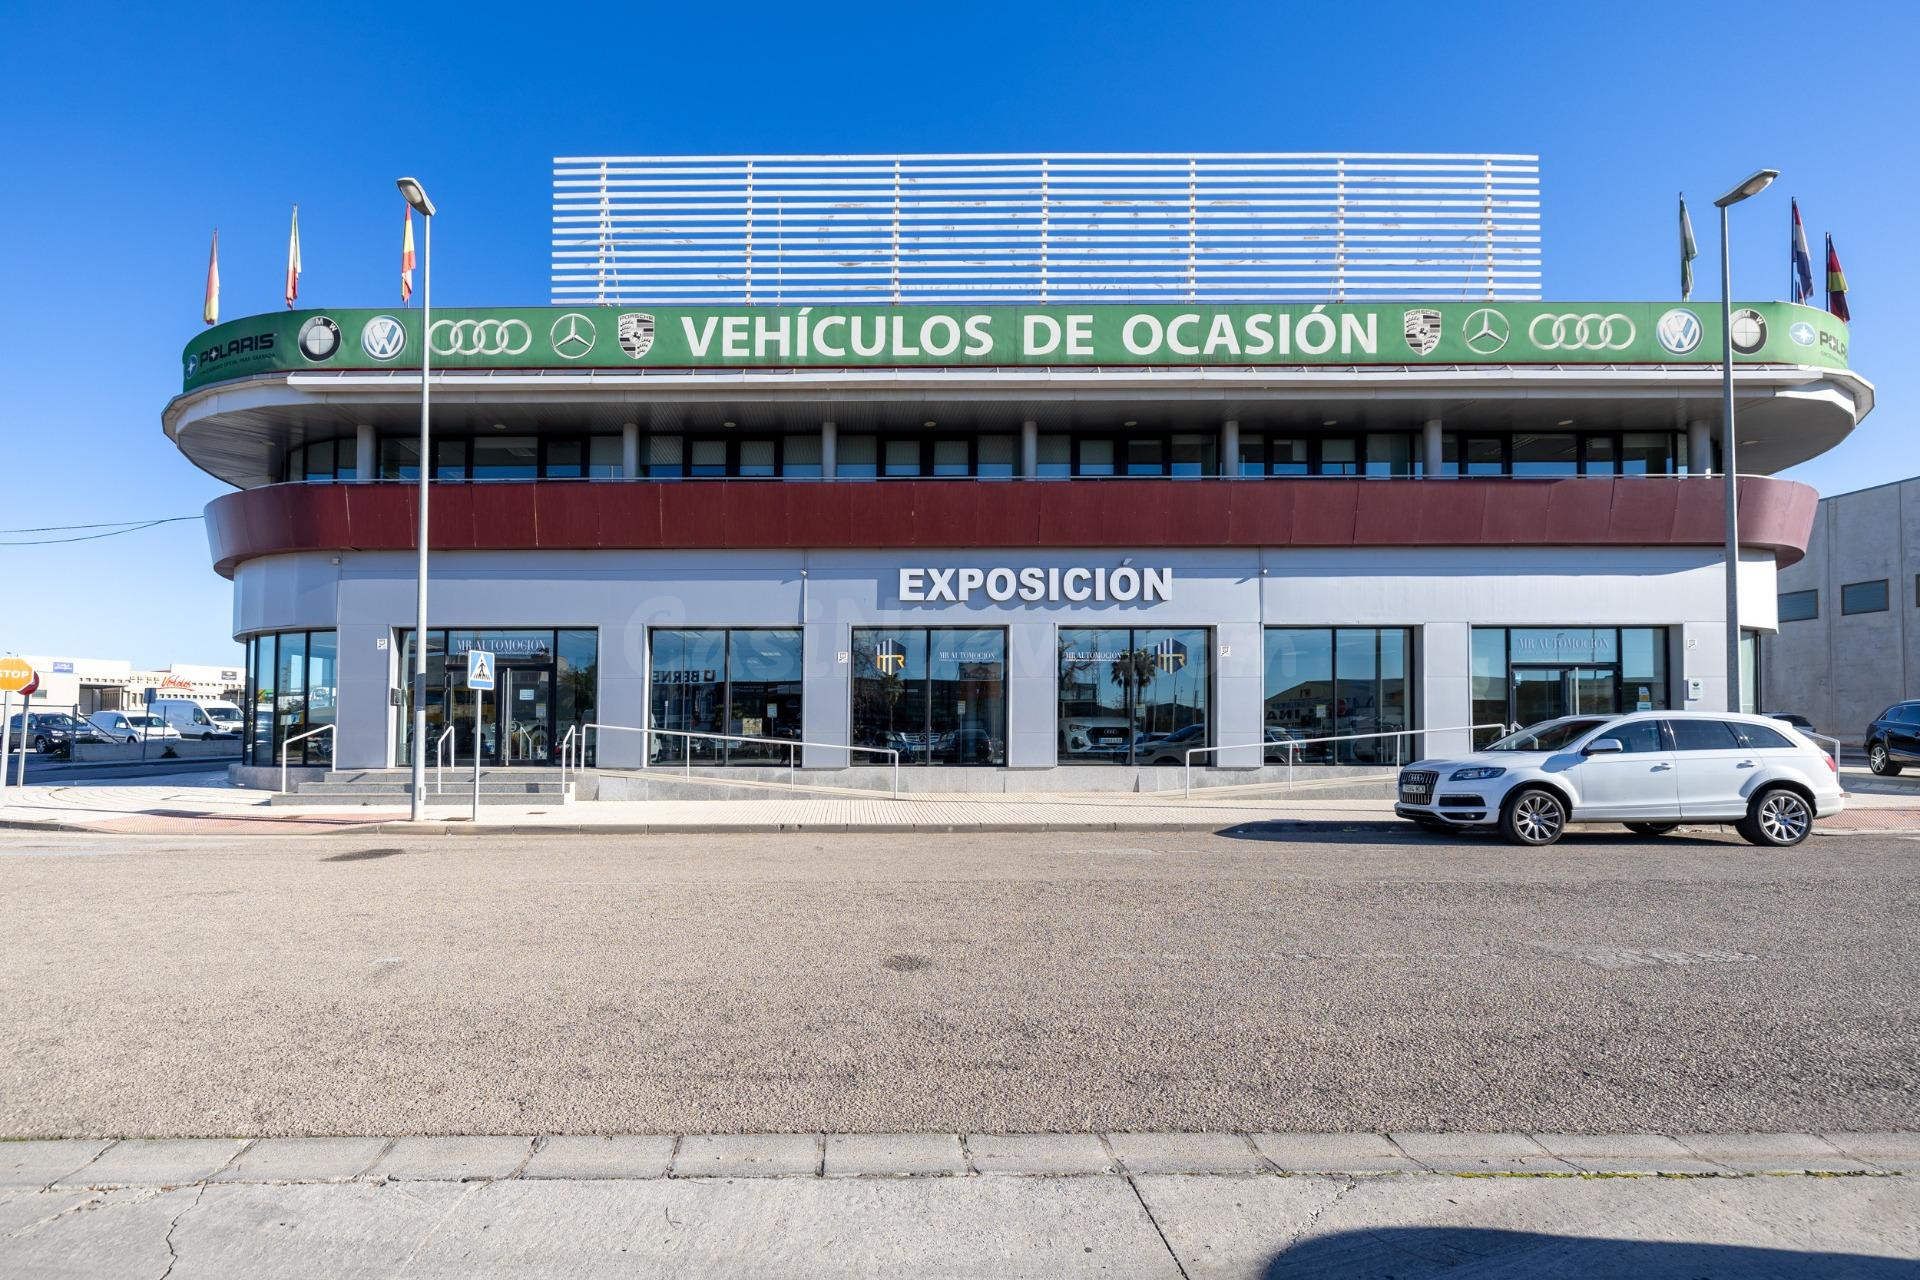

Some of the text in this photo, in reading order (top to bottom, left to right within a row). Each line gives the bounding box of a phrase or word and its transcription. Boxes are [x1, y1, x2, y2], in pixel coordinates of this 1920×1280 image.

[681, 304, 1378, 357] VEHÍCULOS DE OCASIÓN
[200, 333, 274, 367] POLARIS
[900, 558, 1173, 601] EXPOSICIÓN
[457, 640, 472, 650] MR
